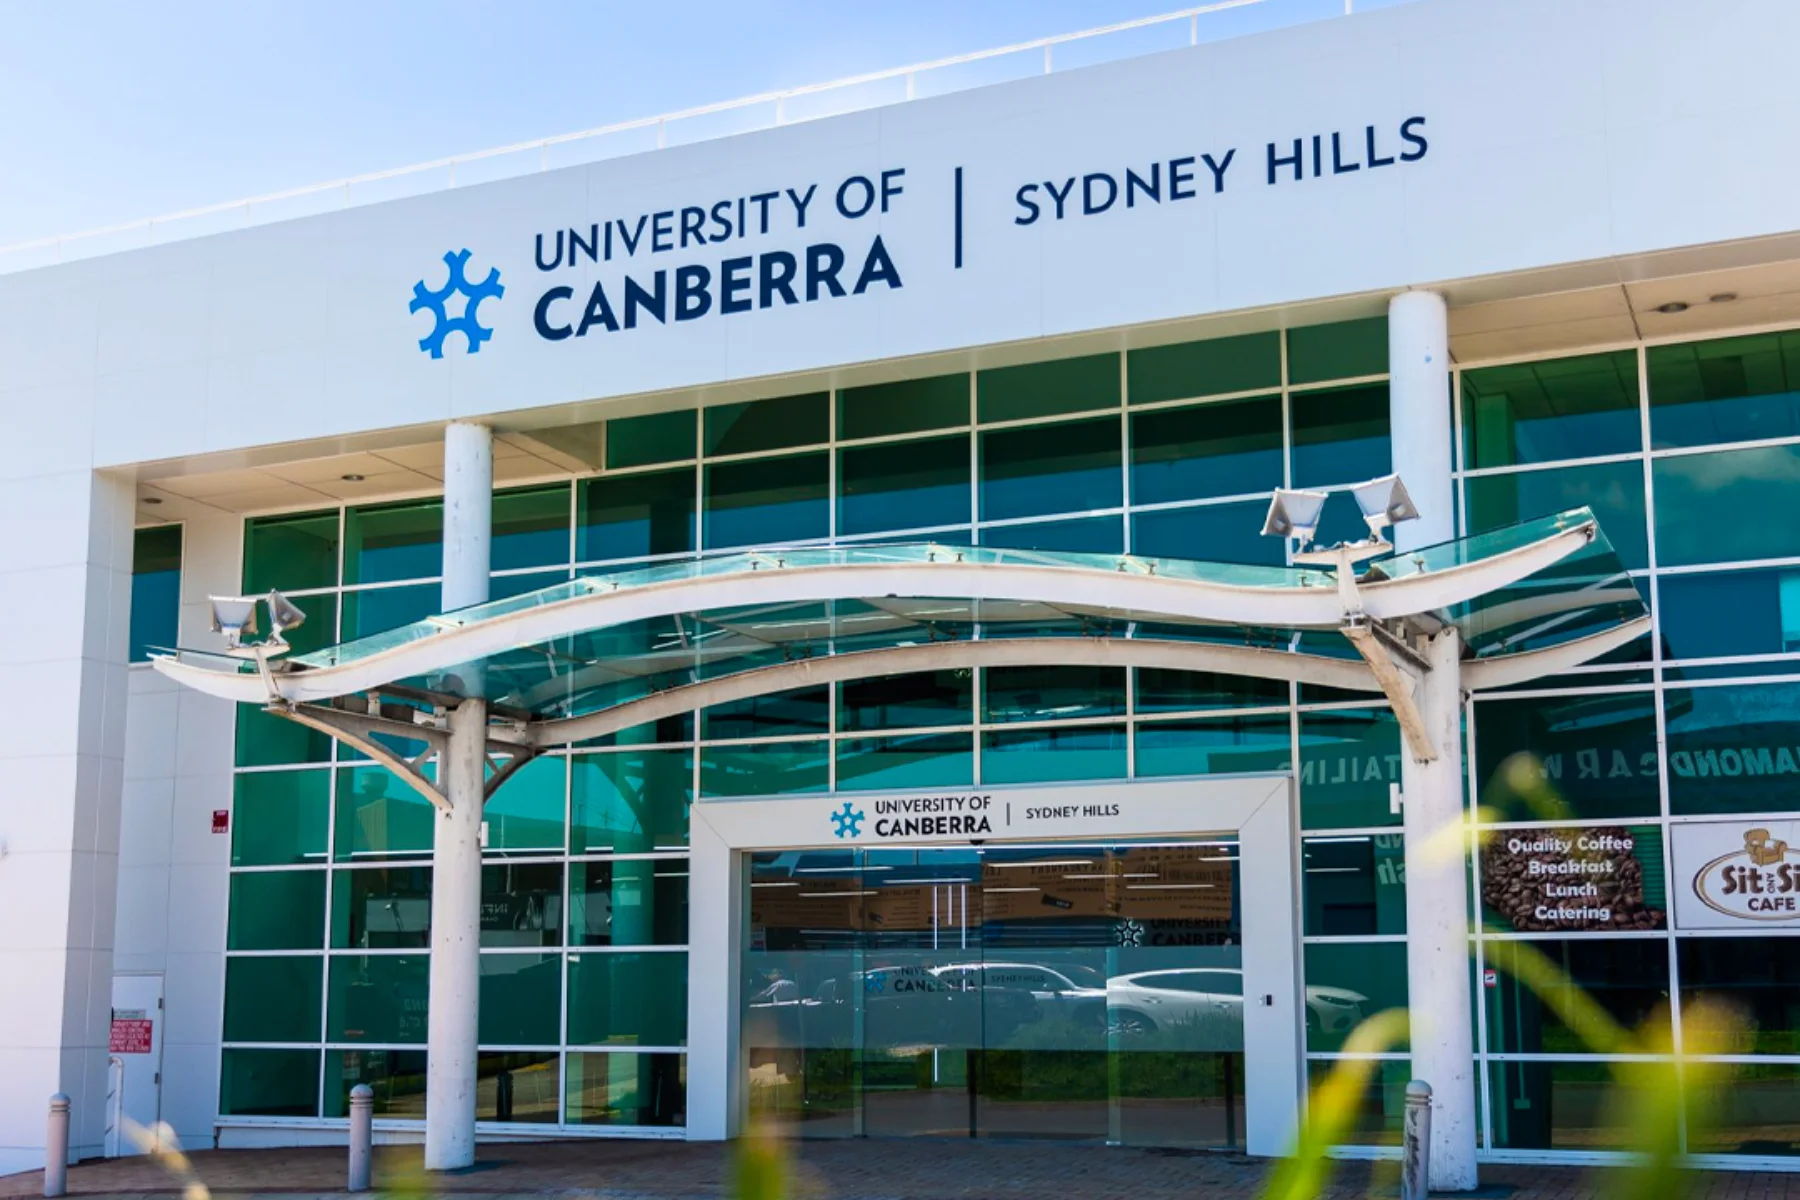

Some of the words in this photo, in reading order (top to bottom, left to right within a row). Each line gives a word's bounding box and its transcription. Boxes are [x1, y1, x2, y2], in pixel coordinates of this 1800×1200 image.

[1014, 148, 1236, 226] SYDNEY
[1266, 116, 1428, 185] HILLS
[534, 184, 818, 272] UNIVERSITY
[835, 167, 906, 219] OF
[533, 234, 903, 341] CANBERRA
[875, 797, 966, 815] UNIVERSITY
[969, 796, 991, 811] OF
[1026, 806, 1079, 820] SYDNEY
[1082, 804, 1120, 817] HILLS
[875, 815, 992, 837] CANBERRA
[1508, 838, 1572, 854] Quality
[1577, 836, 1633, 850] Coffee
[1529, 859, 1614, 874] Breakfast
[1546, 882, 1598, 896] Lunch
[1721, 865, 1764, 895] Sit
[1766, 872, 1775, 893] AND
[1535, 905, 1610, 921] Catering
[1747, 897, 1796, 912] CAFE
